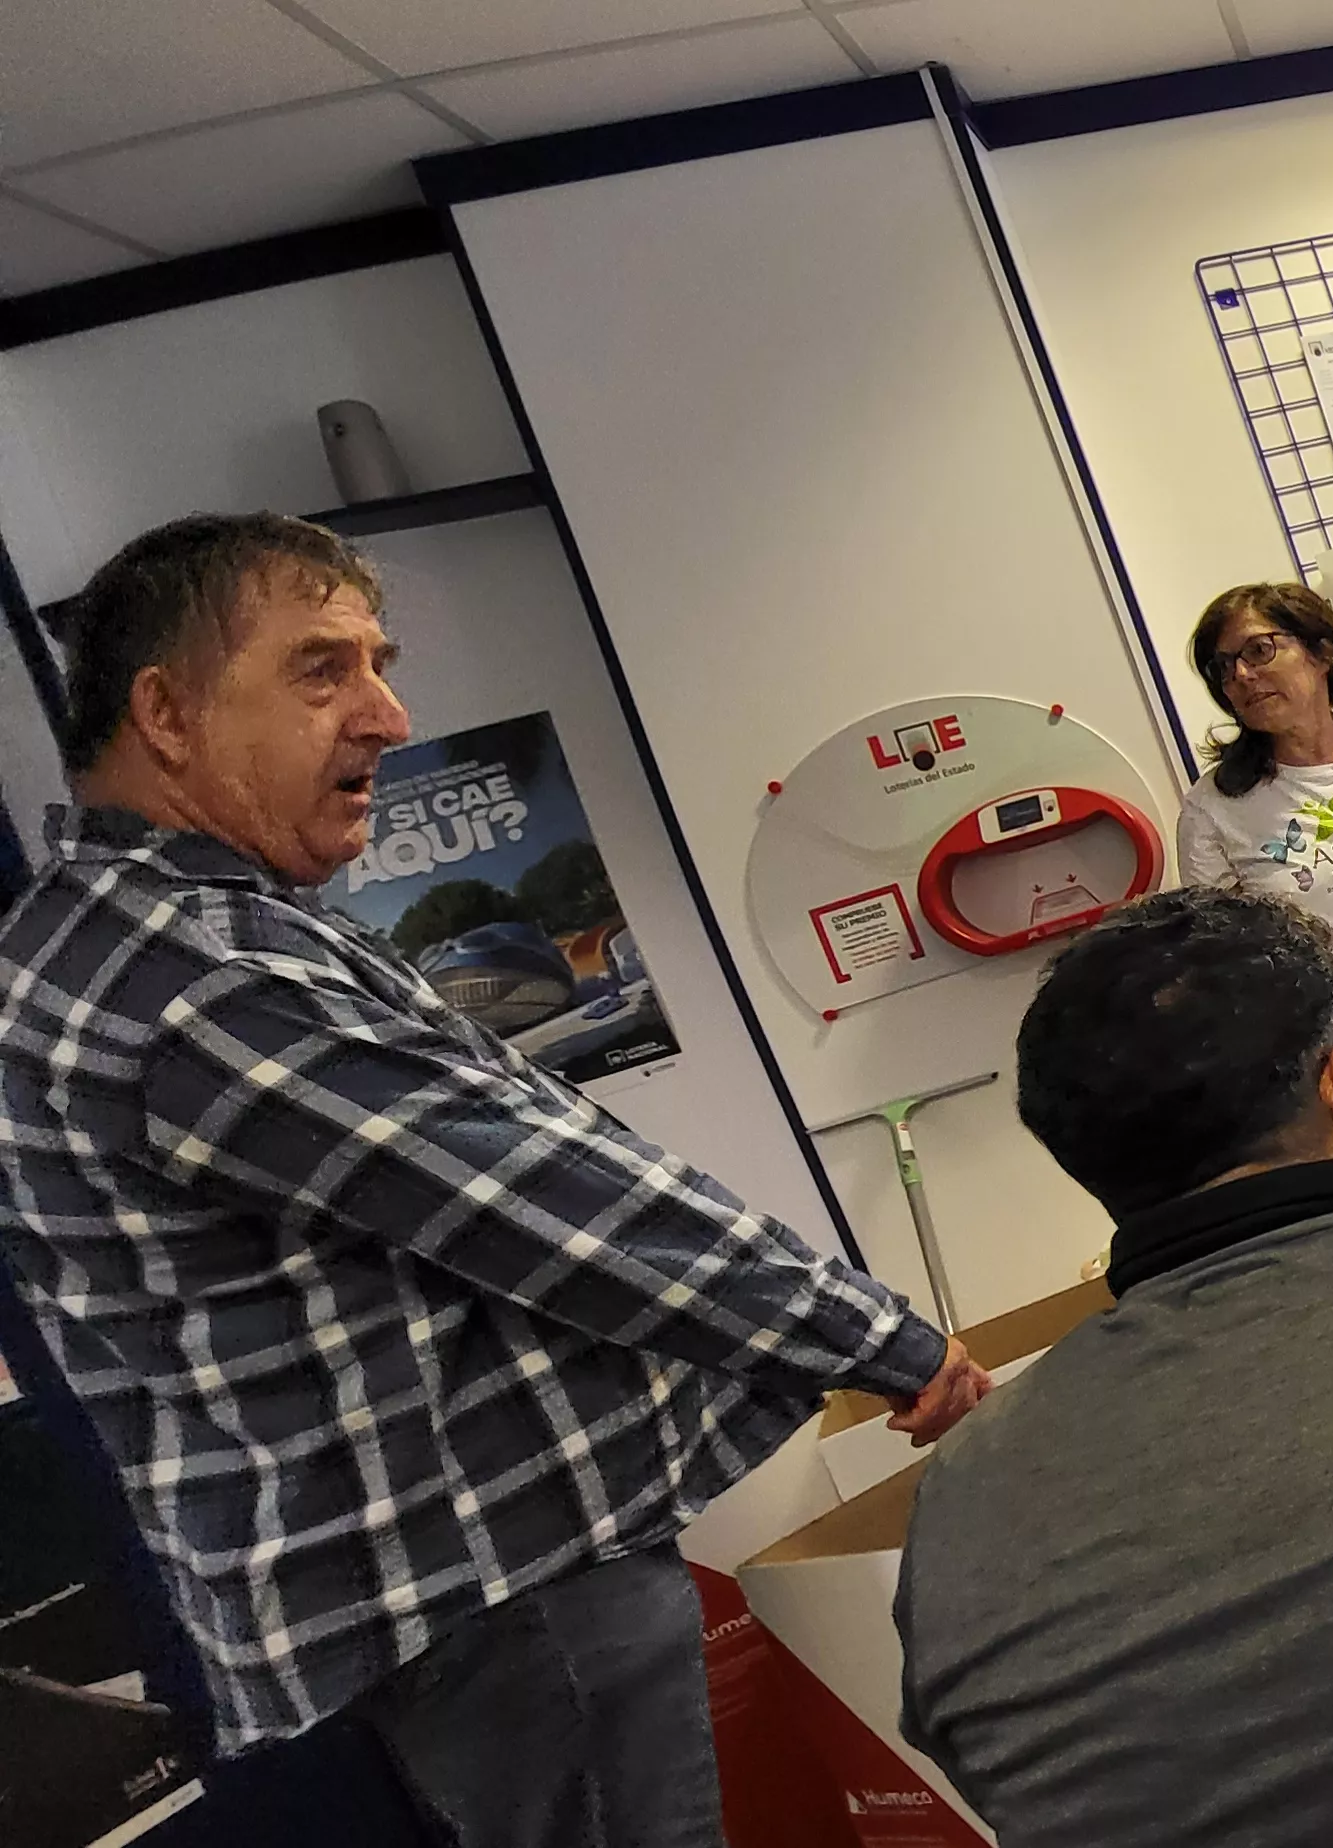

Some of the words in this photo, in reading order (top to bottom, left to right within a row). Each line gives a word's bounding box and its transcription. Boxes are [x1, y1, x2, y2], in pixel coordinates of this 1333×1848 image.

[924, 770, 941, 783] del
[942, 762, 976, 778] Estado
[388, 799, 428, 831] SI
[432, 773, 515, 817] CAE
[347, 799, 528, 895] AQUÍ?
